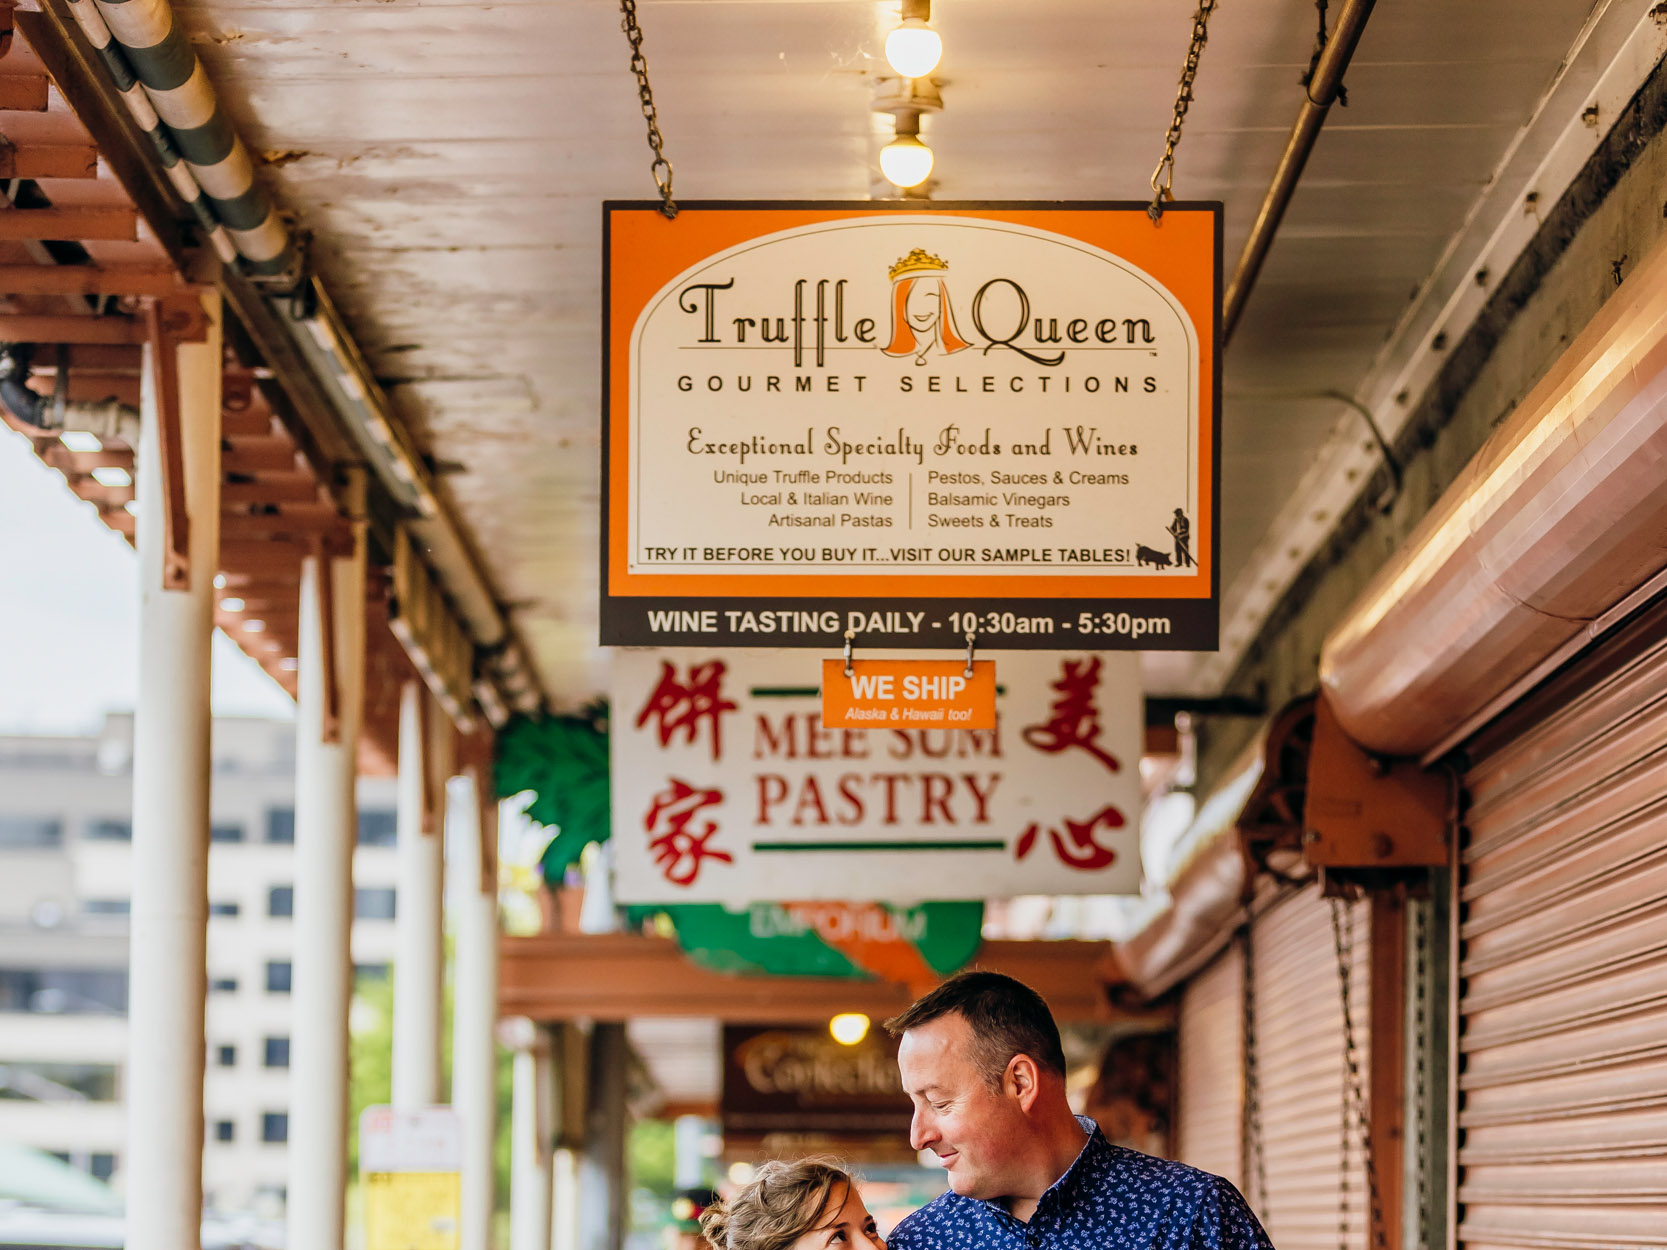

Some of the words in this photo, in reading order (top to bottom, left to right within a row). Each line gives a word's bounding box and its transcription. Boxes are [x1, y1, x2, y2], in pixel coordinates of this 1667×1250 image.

[678, 277, 877, 368] Truffle
[971, 278, 1156, 367] Queen
[677, 375, 868, 393] GOURMET
[899, 375, 1157, 394] SELECTIONS
[686, 426, 815, 465] Exceptional
[823, 426, 925, 466] Specialty
[932, 423, 1002, 457] Foods
[1010, 427, 1053, 456] and
[1061, 425, 1139, 456] Wines
[713, 469, 769, 487] Unique
[772, 469, 821, 485] Truffle
[825, 469, 894, 485] Products
[927, 470, 986, 487] Pestos,
[990, 470, 1048, 485] Sauces
[1052, 470, 1065, 485] &
[1068, 470, 1131, 486] Creams
[740, 491, 783, 506] Local
[786, 491, 799, 506] &
[803, 491, 850, 506] Italian
[853, 491, 894, 506] Wine
[927, 491, 999, 507] Balsamic
[1002, 491, 1071, 510] Vinegars
[768, 512, 836, 528] Artisanal
[840, 512, 894, 528] Pastas
[927, 513, 985, 528] Sweets
[988, 513, 1001, 528] &
[1004, 513, 1054, 528] Treats
[644, 547, 679, 562] TRY
[682, 547, 698, 562] IT
[702, 547, 775, 562] BEFORE
[779, 547, 817, 562] YOU
[821, 547, 858, 562] BUY
[937, 548, 976, 563] OUR
[980, 548, 1053, 563] SAMPLE
[1057, 548, 1131, 563] TABLES!
[647, 610, 719, 633] WINE
[724, 610, 841, 634] TASTING
[848, 611, 926, 634] DAILY
[948, 611, 1055, 634] 10:30am
[1077, 612, 1172, 640] 5:30pm
[850, 674, 895, 701] WE
[901, 675, 967, 701] SHIP
[844, 707, 888, 721] Alaska
[889, 708, 900, 721] &
[902, 708, 945, 721] Hawaii
[947, 708, 973, 721] too!
[753, 711, 870, 760] MEE
[754, 771, 1002, 826] PASTRY
